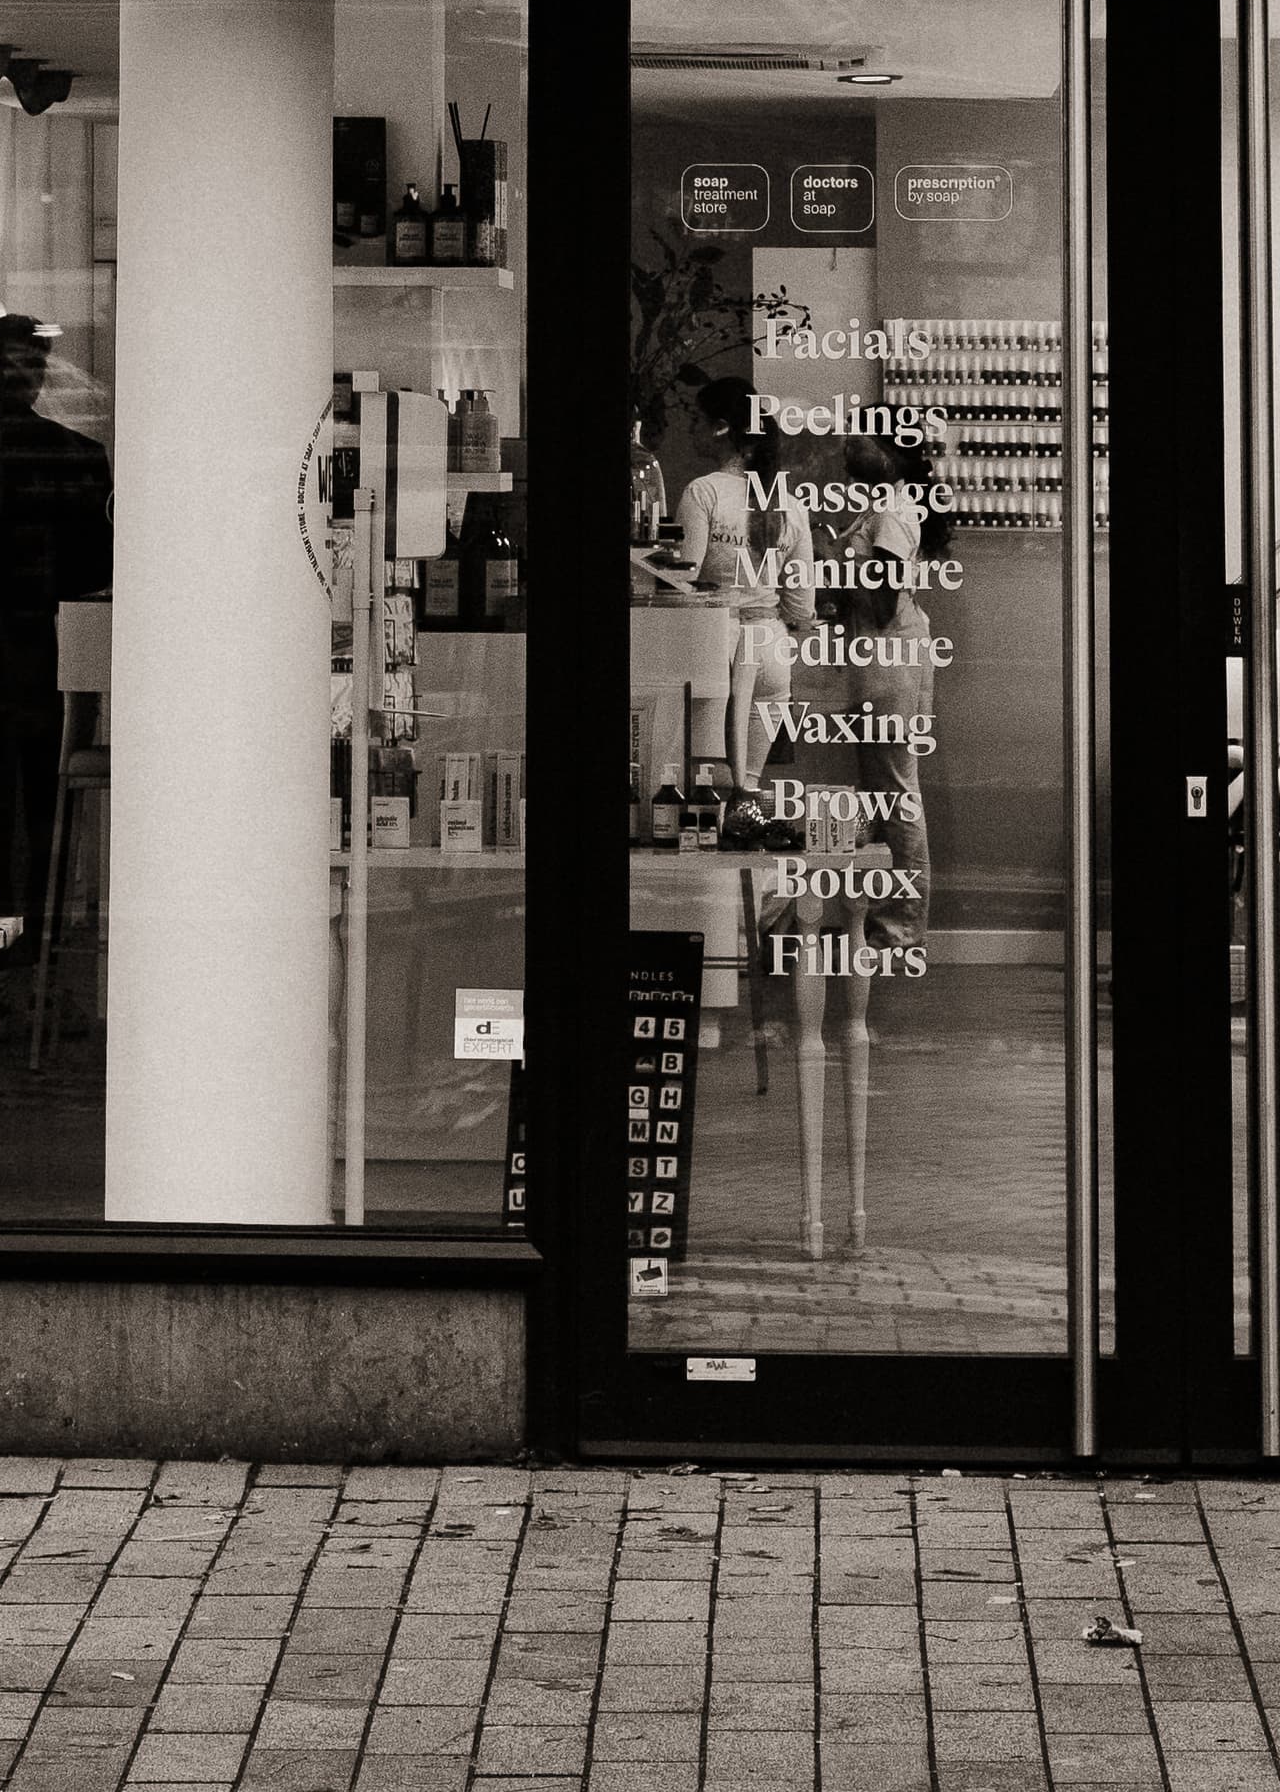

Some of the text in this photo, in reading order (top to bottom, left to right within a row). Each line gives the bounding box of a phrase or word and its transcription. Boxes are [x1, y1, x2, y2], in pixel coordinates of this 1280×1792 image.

[693, 177, 729, 190] soap
[803, 175, 859, 189] doctors
[693, 188, 758, 201] treatment
[803, 190, 817, 201] at
[907, 190, 960, 204] by soap
[693, 201, 728, 214] store
[803, 203, 837, 216] soap
[760, 317, 931, 361] Facials
[744, 393, 949, 448] Peelings
[743, 470, 955, 524] Massage
[729, 547, 964, 590] Manicure
[1233, 597, 1242, 644] DUWEN
[738, 623, 954, 667] Pedicure
[755, 701, 937, 756] Waxing
[769, 779, 923, 822] Brows
[772, 856, 922, 900] Botox
[768, 933, 928, 978] Fillers
[638, 1019, 680, 1037] 4 5
[463, 1042, 513, 1054] EXPERT
[664, 1054, 678, 1070] B
[630, 1088, 678, 1106] G H
[630, 1122, 674, 1140] M N
[631, 1159, 645, 1176] S
[660, 1159, 673, 1175] T
[655, 1194, 669, 1211] Z
